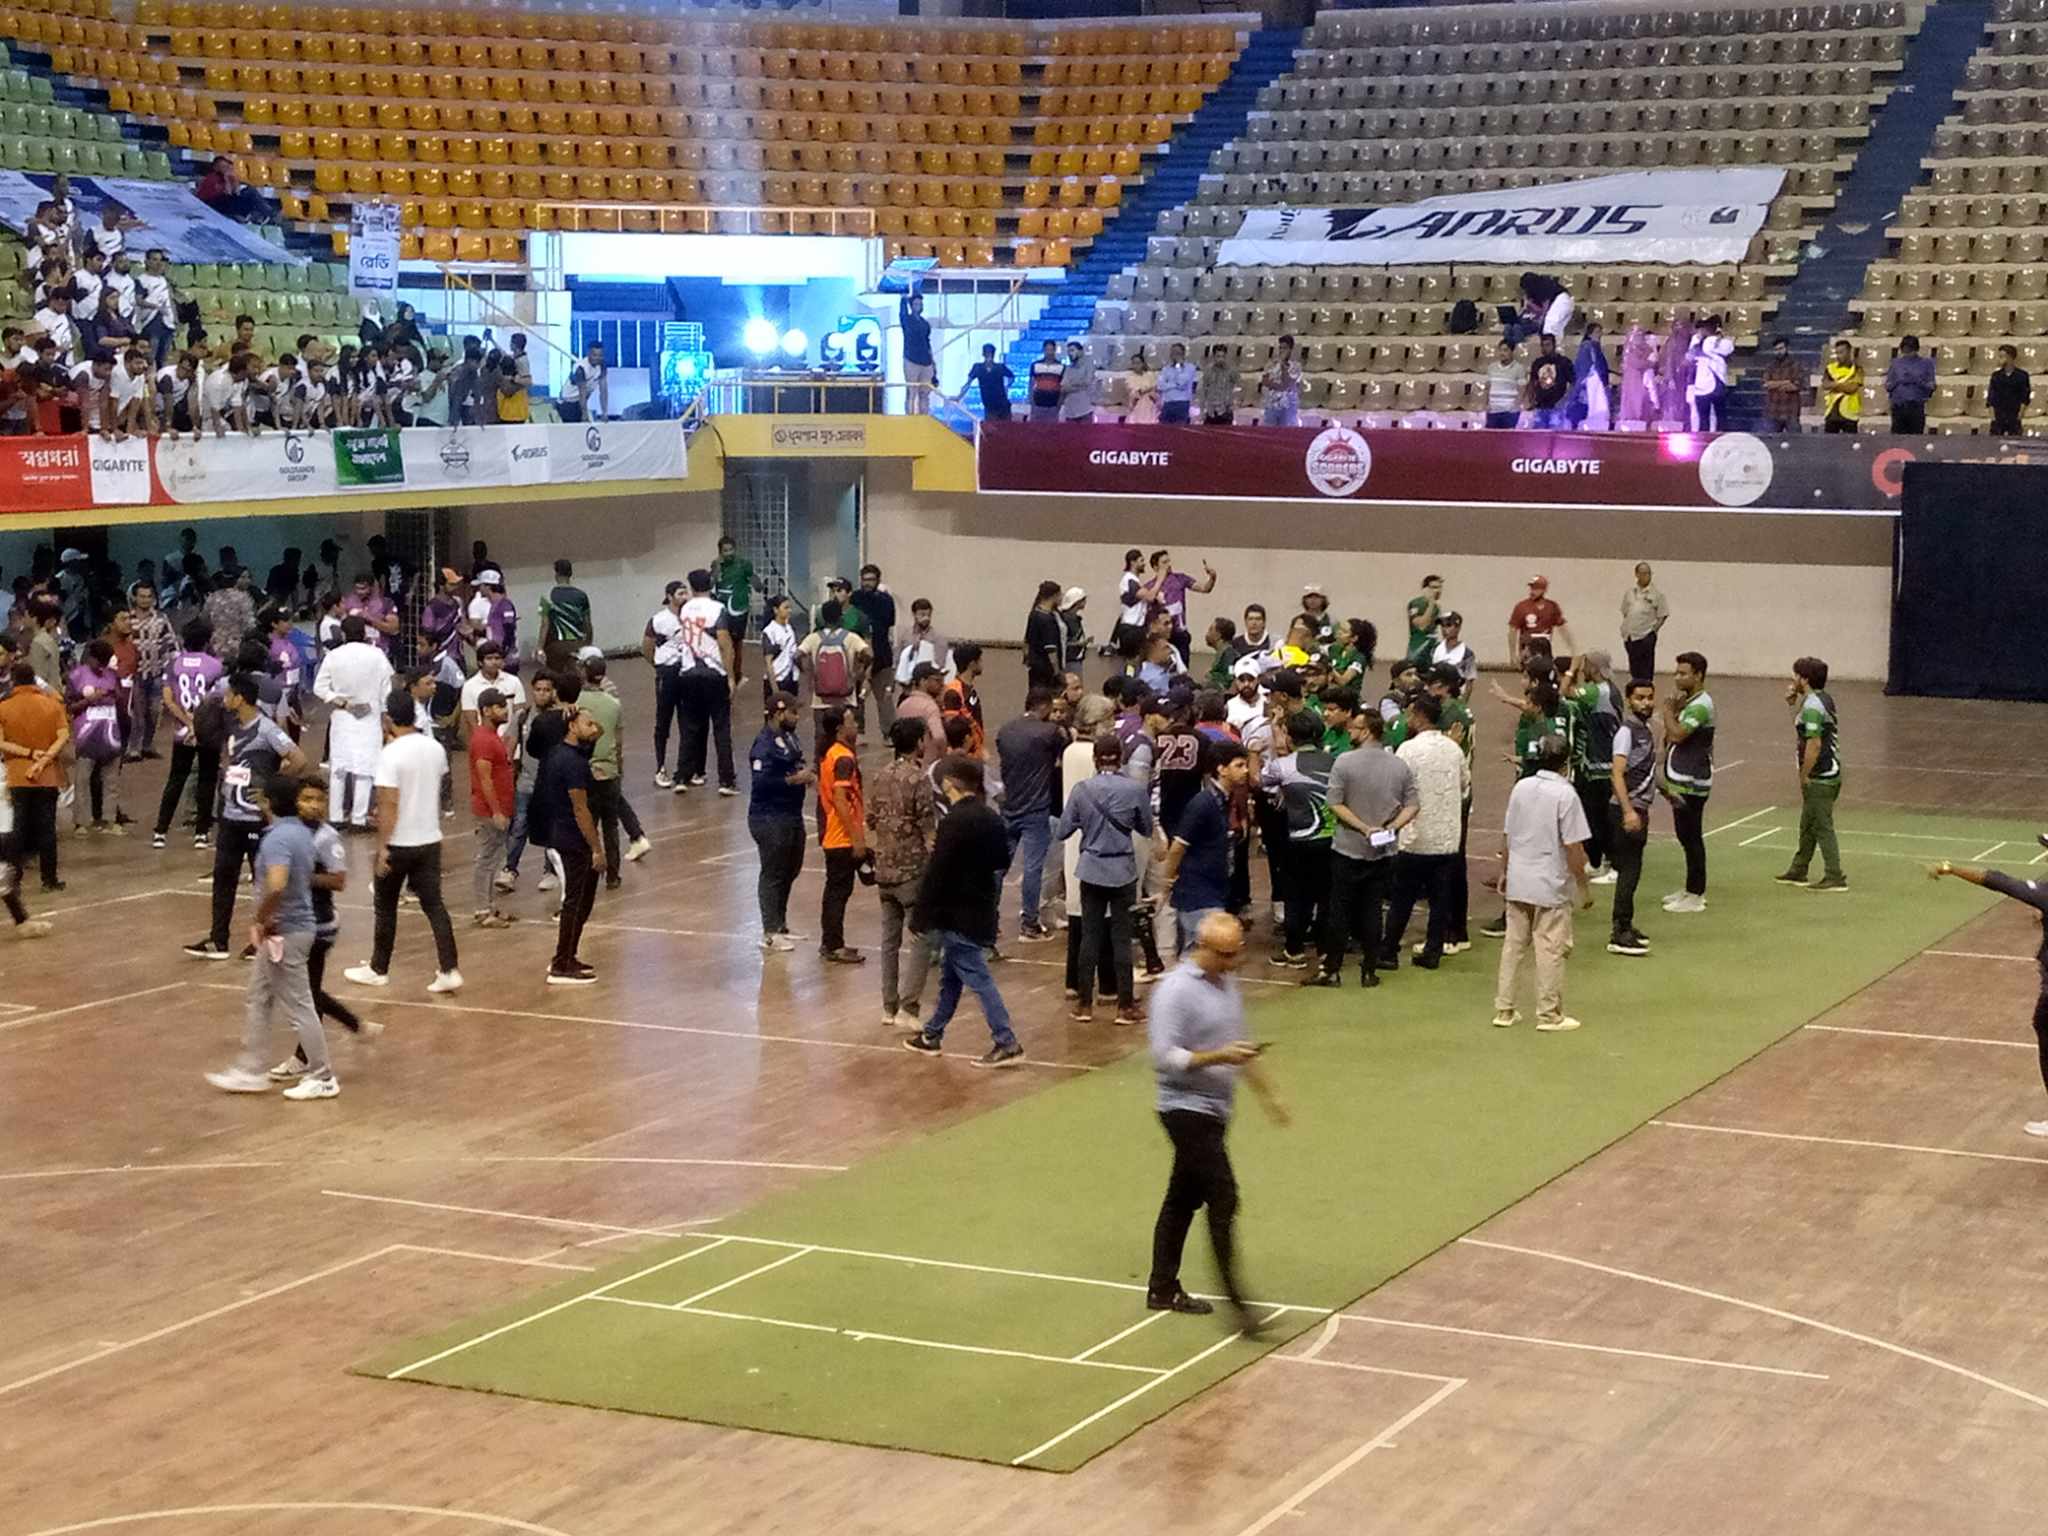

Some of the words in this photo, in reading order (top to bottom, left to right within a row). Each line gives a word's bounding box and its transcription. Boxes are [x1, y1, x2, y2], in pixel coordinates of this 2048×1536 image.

[92, 458, 145, 472] GIGABYTE
[1088, 449, 1169, 466] GIGABYTE
[1511, 458, 1601, 474] GIGABYTE
[178, 673, 206, 710] 83
[1157, 734, 1199, 770] 23
